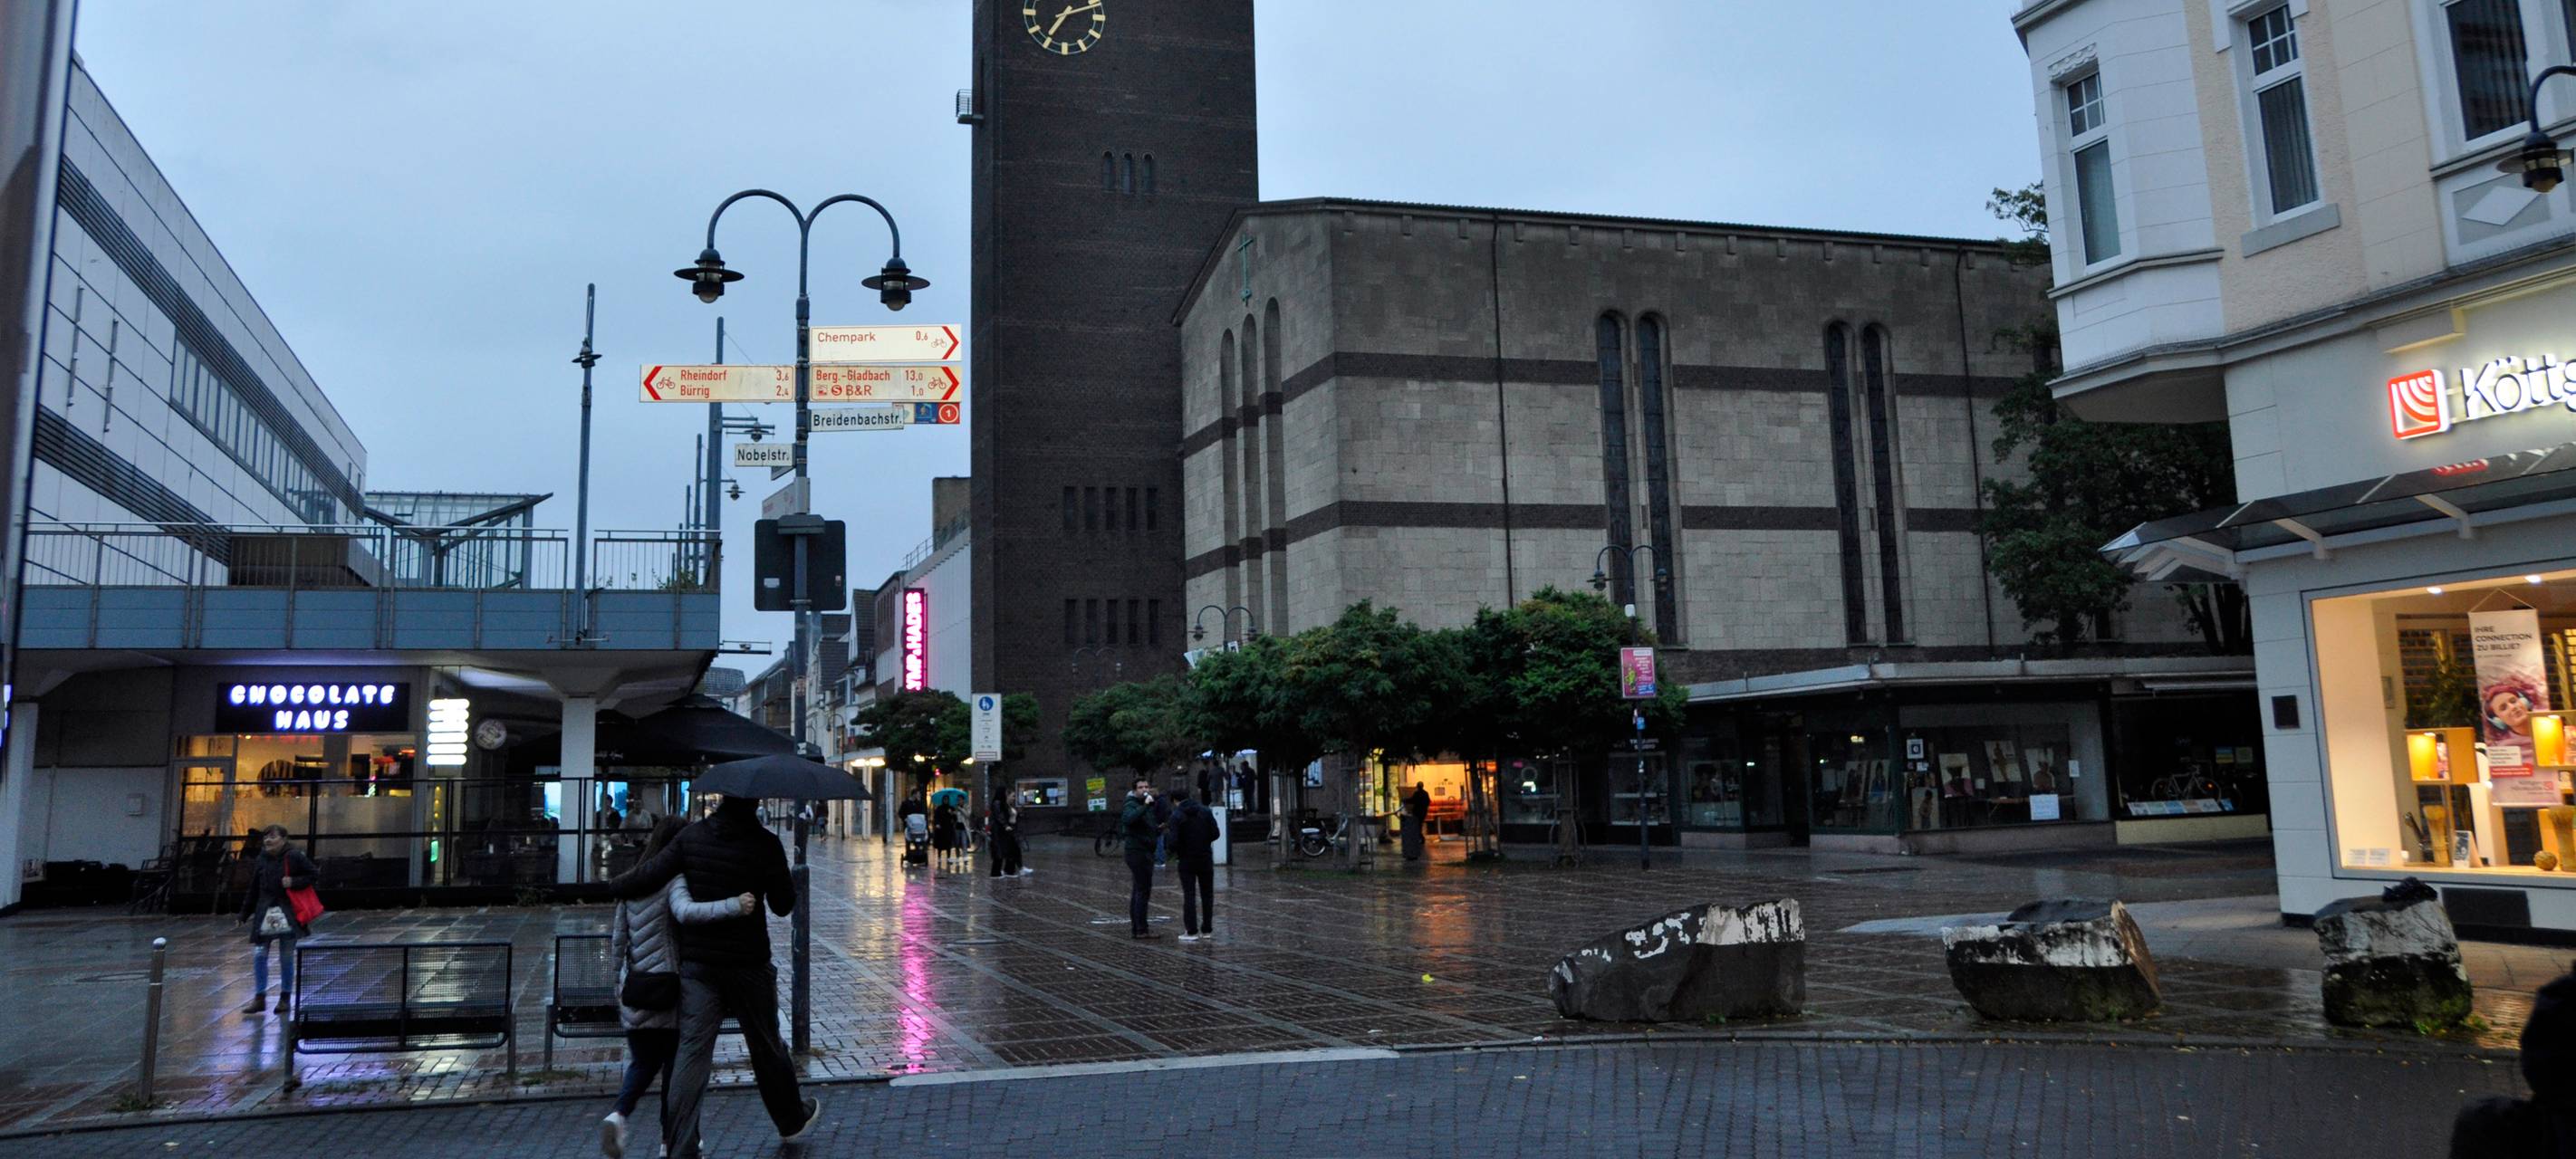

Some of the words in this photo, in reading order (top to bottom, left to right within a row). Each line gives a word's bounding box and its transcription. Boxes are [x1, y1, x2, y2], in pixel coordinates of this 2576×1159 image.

[818, 331, 876, 344] Chempark
[680, 369, 727, 381] Rheindorf
[816, 369, 890, 384] Berg.-Gladbach
[680, 386, 710, 398] Bürrig
[845, 385, 872, 397] B&R
[813, 412, 902, 427] Breidenbachstr.
[737, 448, 790, 461] Nobelstr.
[2475, 633, 2533, 643] CONNECTION
[230, 685, 396, 704] CHOCOLATE
[274, 709, 350, 730] HAUS
